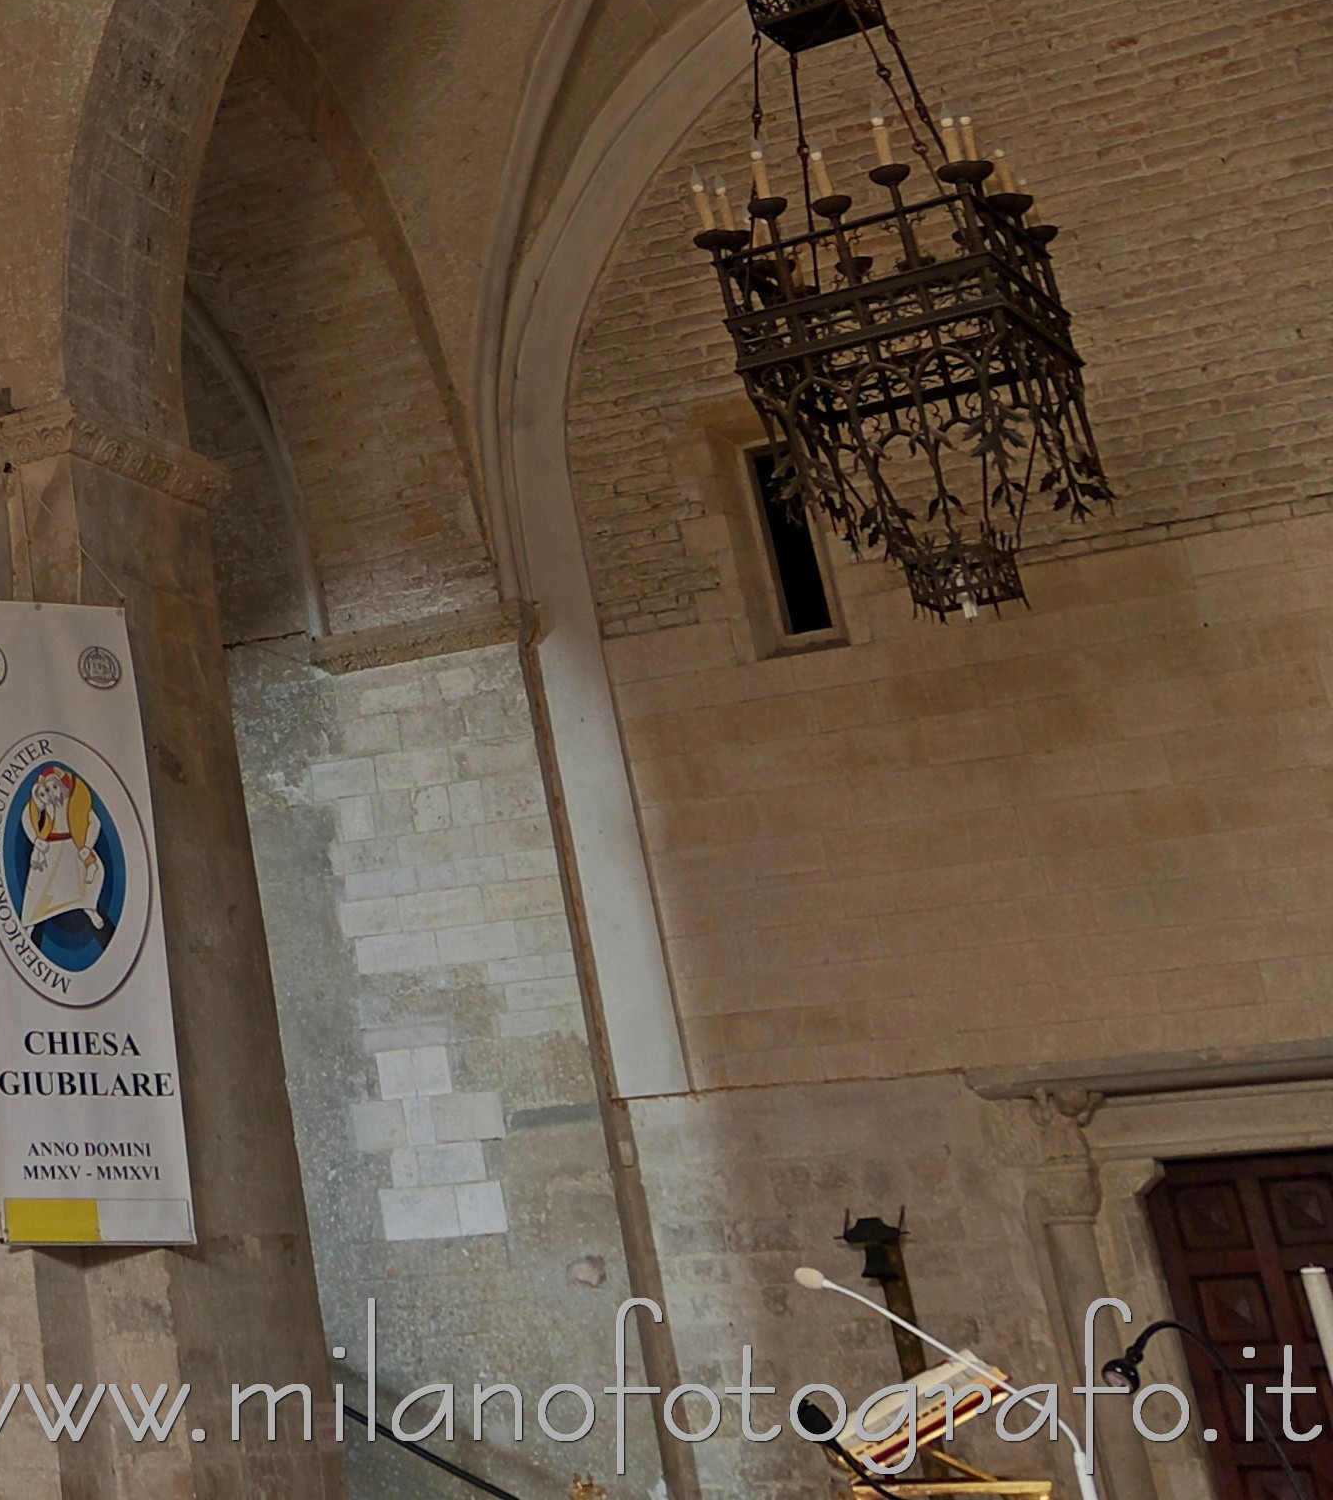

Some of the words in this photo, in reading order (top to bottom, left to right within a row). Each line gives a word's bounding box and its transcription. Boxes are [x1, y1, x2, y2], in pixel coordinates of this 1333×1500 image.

[1, 738, 54, 786] PATER
[23, 1030, 141, 1057] CHIESA
[27, 1141, 79, 1157] ANNO
[84, 1142, 152, 1158] DOMINI
[23, 1165, 81, 1180] MMXV
[96, 1165, 161, 1181] MMXVI
